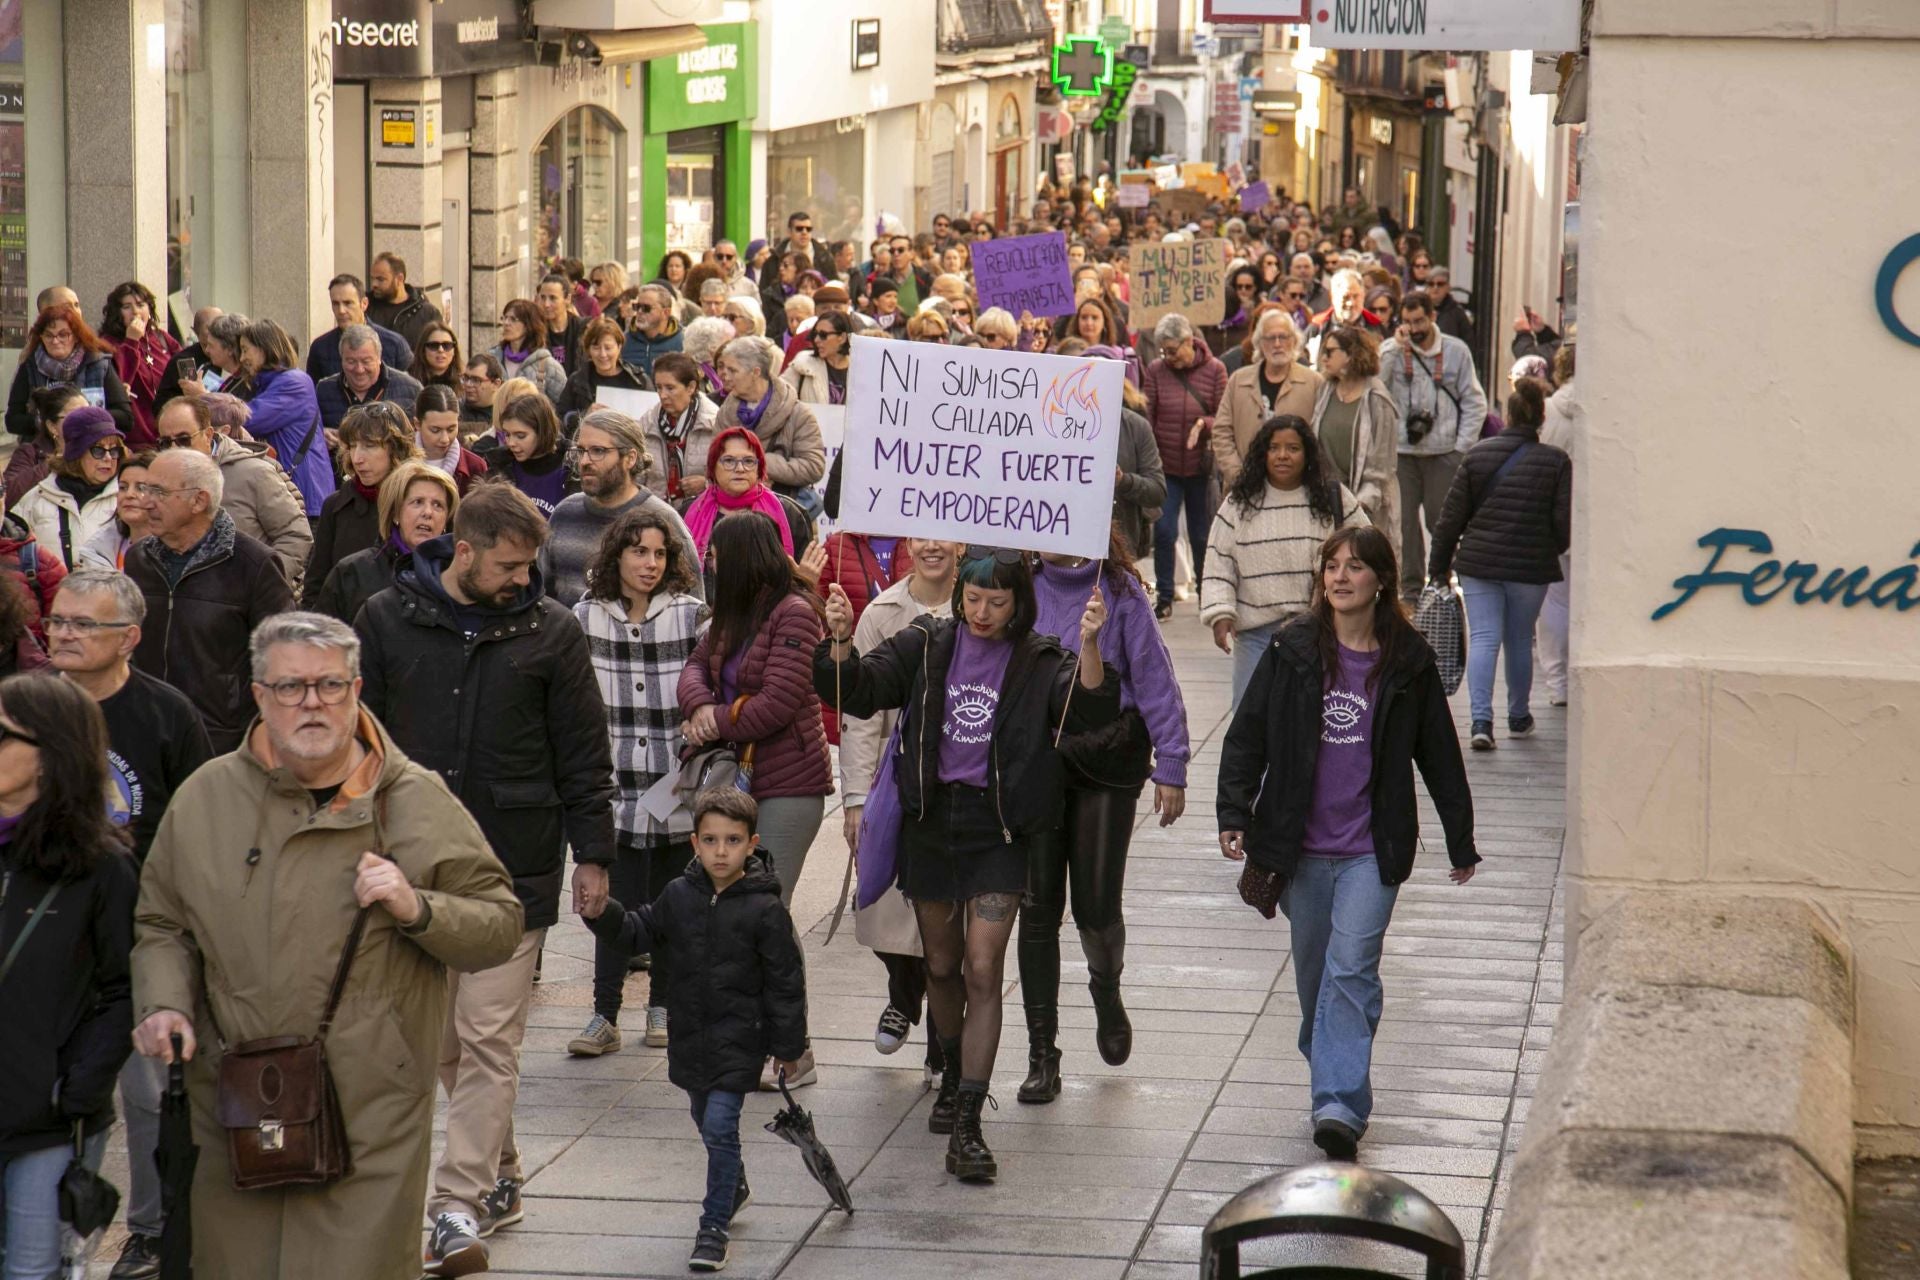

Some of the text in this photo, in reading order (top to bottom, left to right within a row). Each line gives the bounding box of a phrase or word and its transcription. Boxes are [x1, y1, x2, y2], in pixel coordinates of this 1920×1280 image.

[1141, 240, 1216, 272] MUJER
[1142, 286, 1215, 308] QUE SER
[880, 349, 1039, 399] NI SUMISA
[879, 397, 1034, 437] NI CALLADA
[1060, 416, 1088, 441] 8M
[874, 436, 982, 479] MUJER
[1001, 450, 1095, 484] FUERTE
[868, 486, 1070, 536] Y EMPODERADA
